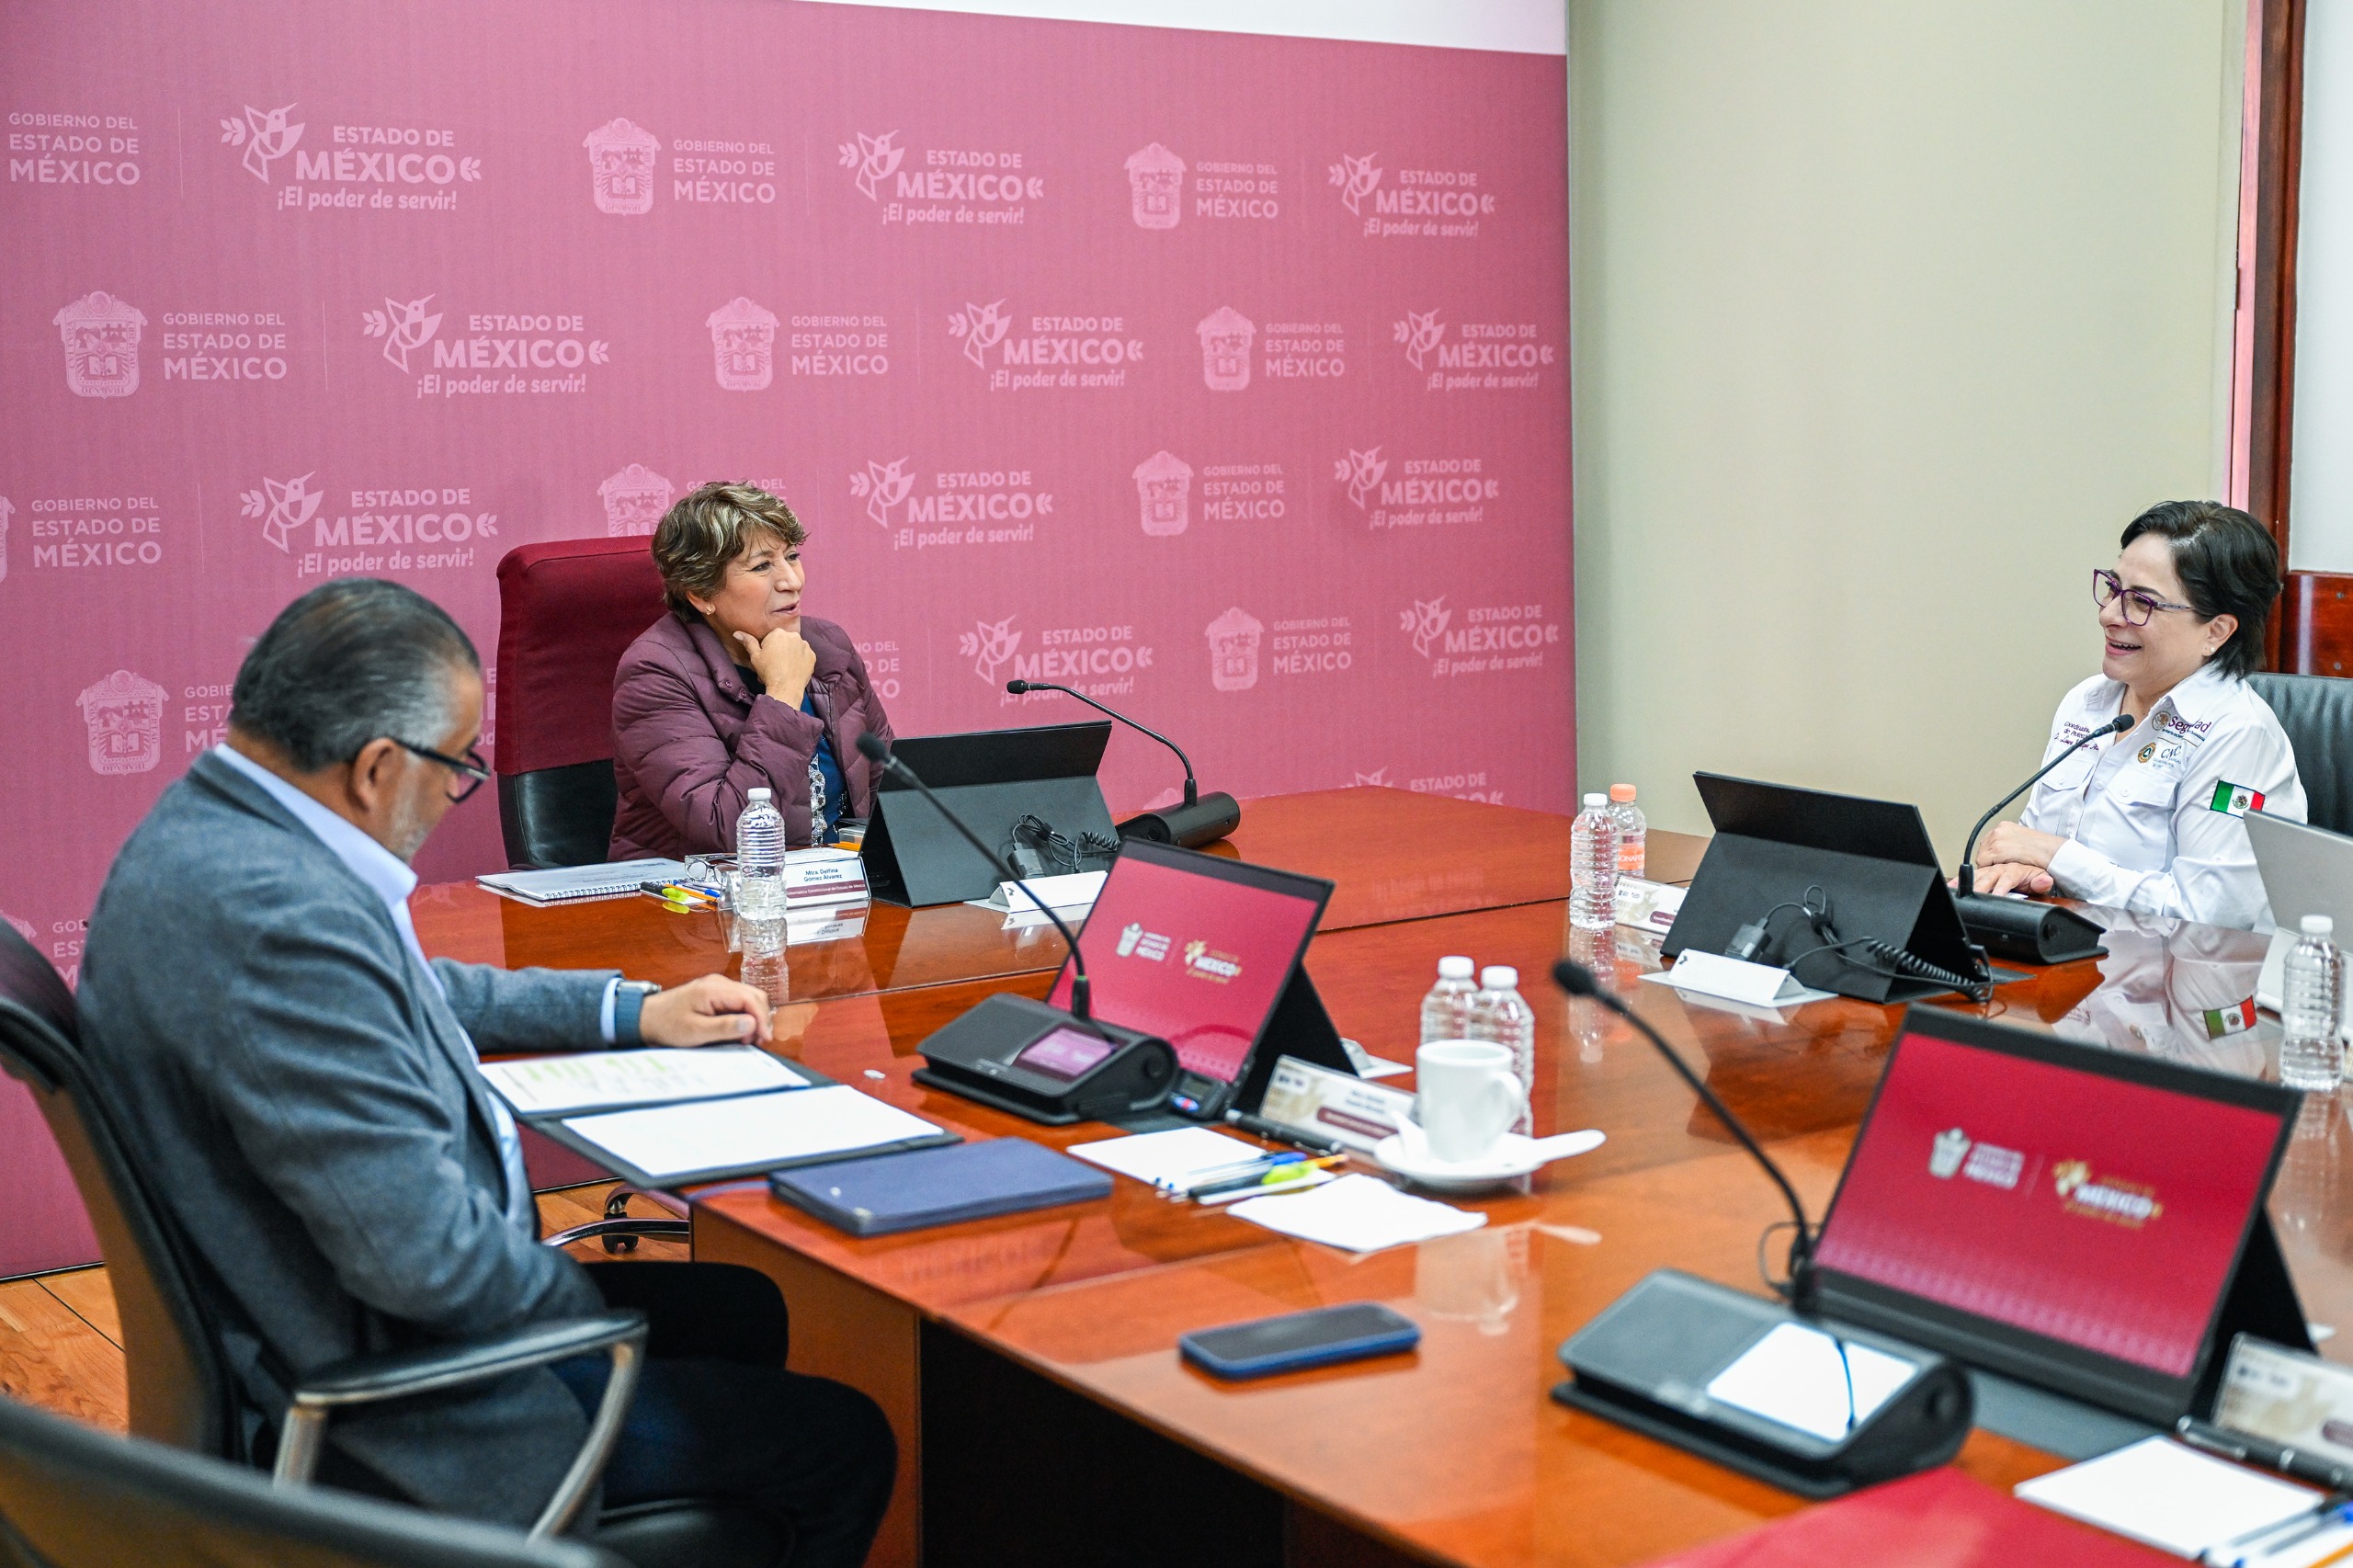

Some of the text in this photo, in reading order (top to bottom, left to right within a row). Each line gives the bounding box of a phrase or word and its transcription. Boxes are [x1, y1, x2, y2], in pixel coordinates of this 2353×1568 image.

[9, 113, 138, 130] GOBIERNO DEL
[10, 134, 139, 153] ESTADO DE
[334, 126, 454, 146] ESTADO DE
[674, 139, 774, 154] GOBIERNO DEL
[296, 148, 455, 184] MÉXICO
[674, 158, 775, 176] ESTADO DE
[927, 150, 1022, 168] ESTADO DE
[1197, 162, 1278, 175] GOBIERNO DEL
[10, 153, 140, 185] MÉXICO
[1400, 170, 1477, 187] ESTADO DE
[675, 176, 775, 203] MÉXICO
[897, 169, 1023, 201] MÉXICO
[1197, 178, 1278, 194] ESTADO DE
[278, 187, 456, 211] ¡El poder de servir!
[1197, 194, 1279, 219] MÉXICO
[1376, 187, 1478, 216] MÉXICO
[882, 203, 1024, 225] ¡El poder de servir!
[163, 313, 285, 325] GOBIERNO DEL
[470, 315, 584, 331] ESTADO DE
[791, 316, 887, 326] GOBIERNO DEL
[1032, 317, 1122, 332] ESTADO DE
[1266, 324, 1344, 334] GOBIERNO DEL
[1462, 324, 1536, 338] ESTADO DE
[164, 334, 286, 349] ESTADO DE
[791, 334, 887, 347] ESTADO DE
[1004, 335, 1123, 364] MÉXICO
[1266, 339, 1344, 352] ESTADO DE
[434, 335, 584, 368] MÉXICO
[1438, 341, 1538, 368] MÉXICO
[165, 351, 287, 380] MÉXICO
[792, 350, 888, 375] MÉXICO
[1266, 354, 1345, 377] MÉXICO
[417, 374, 585, 398] ¡El poder de servir!
[991, 369, 1125, 391] ¡El poder de servir!
[1203, 464, 1283, 476] GOBIERNO DEL
[1404, 459, 1481, 474] ESTADO DE
[761, 478, 786, 489] DEL
[938, 471, 1031, 488] ESTADO DE
[1204, 481, 1284, 495] ESTADO DE
[351, 488, 470, 507] ESTADO DE
[1381, 477, 1482, 505] MÉXICO
[32, 497, 159, 512] GOBIERNO DEL
[908, 492, 1032, 523] MÉXICO
[1204, 496, 1284, 520] MÉXICO
[32, 517, 160, 536] ESTADO DE
[315, 512, 472, 546] MÉXICO
[894, 524, 1033, 551] ¡El poder de servir!
[34, 538, 161, 567] MÉXICO
[297, 548, 473, 577] ¡El poder de servir!
[1468, 605, 1542, 622] ESTADO DE
[1274, 618, 1350, 631] GOBIERNO DEL
[1042, 626, 1132, 645] ESTADO DE
[1274, 632, 1350, 650] ESTADO DE
[1445, 625, 1542, 653] MÉXICO
[875, 641, 899, 652] DEL
[878, 658, 900, 673] DE
[1015, 647, 1133, 679] MÉXICO
[1274, 650, 1351, 674] MÉXICO
[184, 684, 233, 698] GOBIE
[1089, 676, 1133, 697] servir!
[1410, 772, 1485, 792] ESTADO DE
